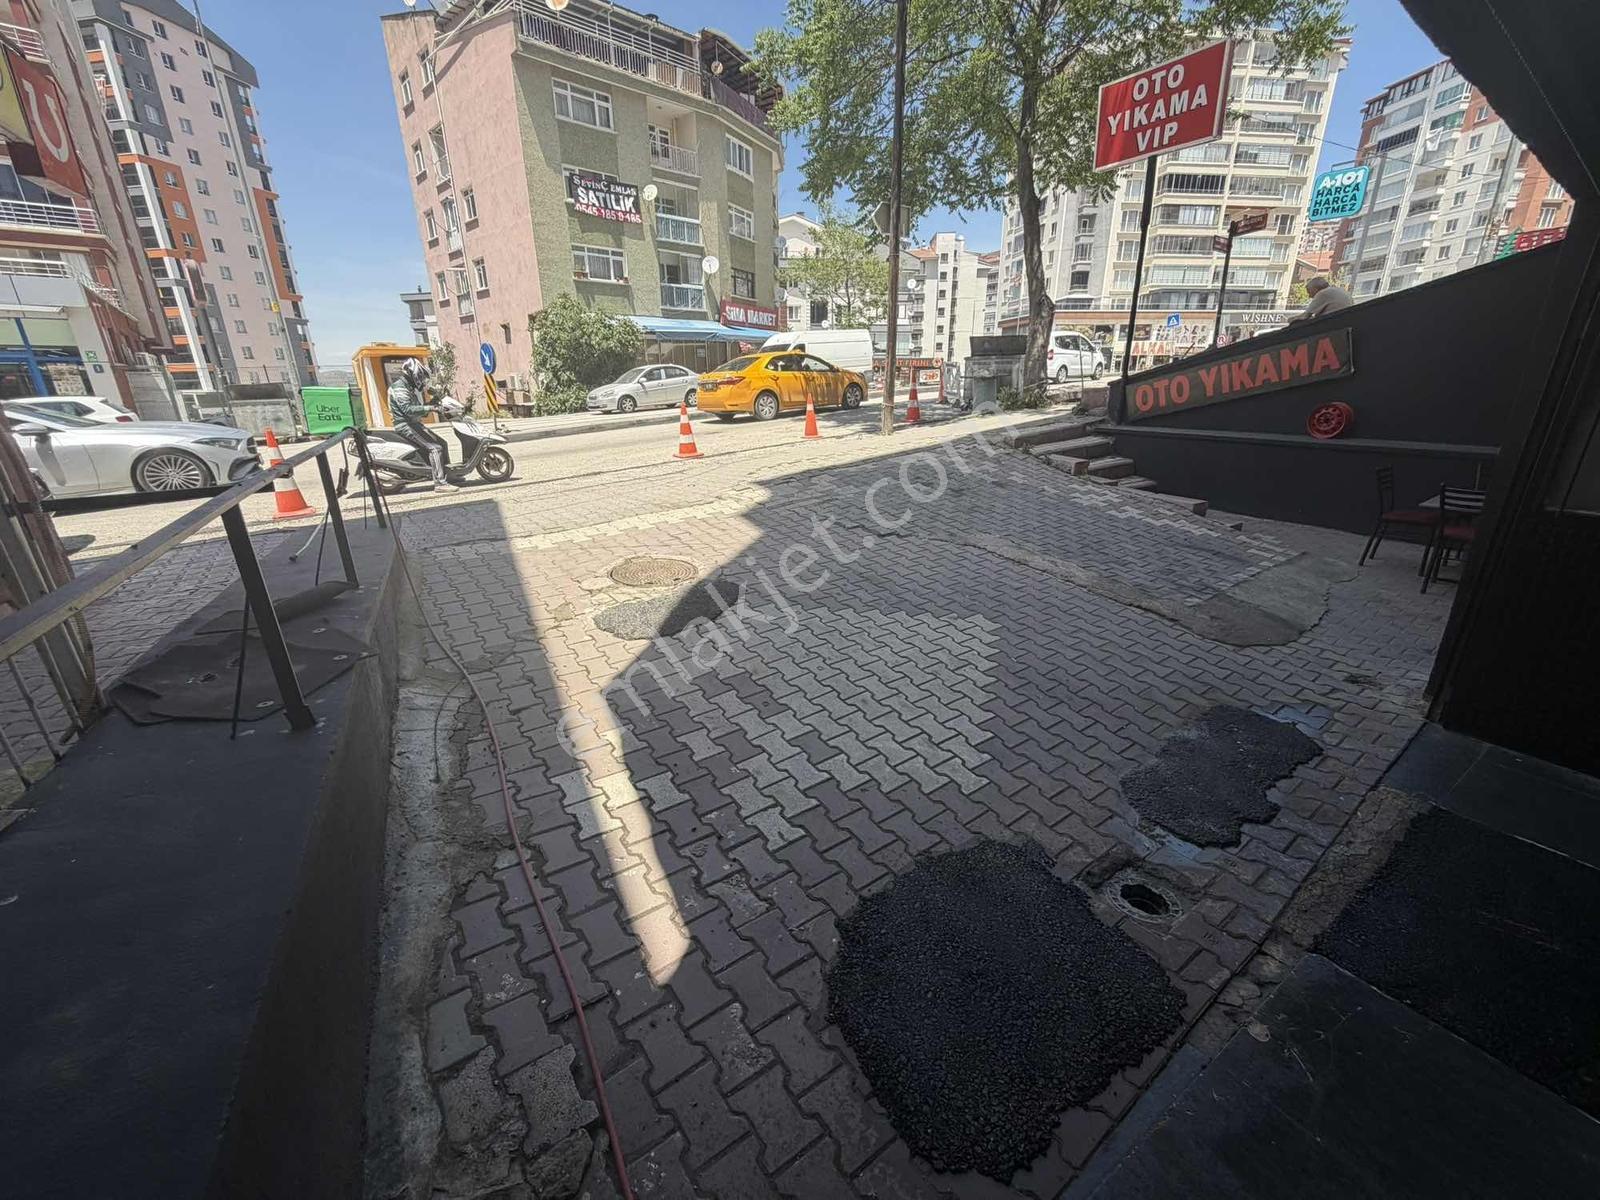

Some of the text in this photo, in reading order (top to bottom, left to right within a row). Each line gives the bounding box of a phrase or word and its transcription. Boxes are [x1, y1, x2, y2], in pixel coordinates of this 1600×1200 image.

[1132, 64, 1185, 102] OTO
[1107, 84, 1208, 136] YIKAMA
[1136, 121, 1178, 152] VIP
[1315, 183, 1360, 199] HARCA
[1313, 193, 1357, 208] HARCA
[747, 309, 776, 326] MARKET
[1135, 336, 1340, 412] OTO YIKAMA
[316, 404, 341, 413] Uber
[317, 413, 342, 421] Eats
